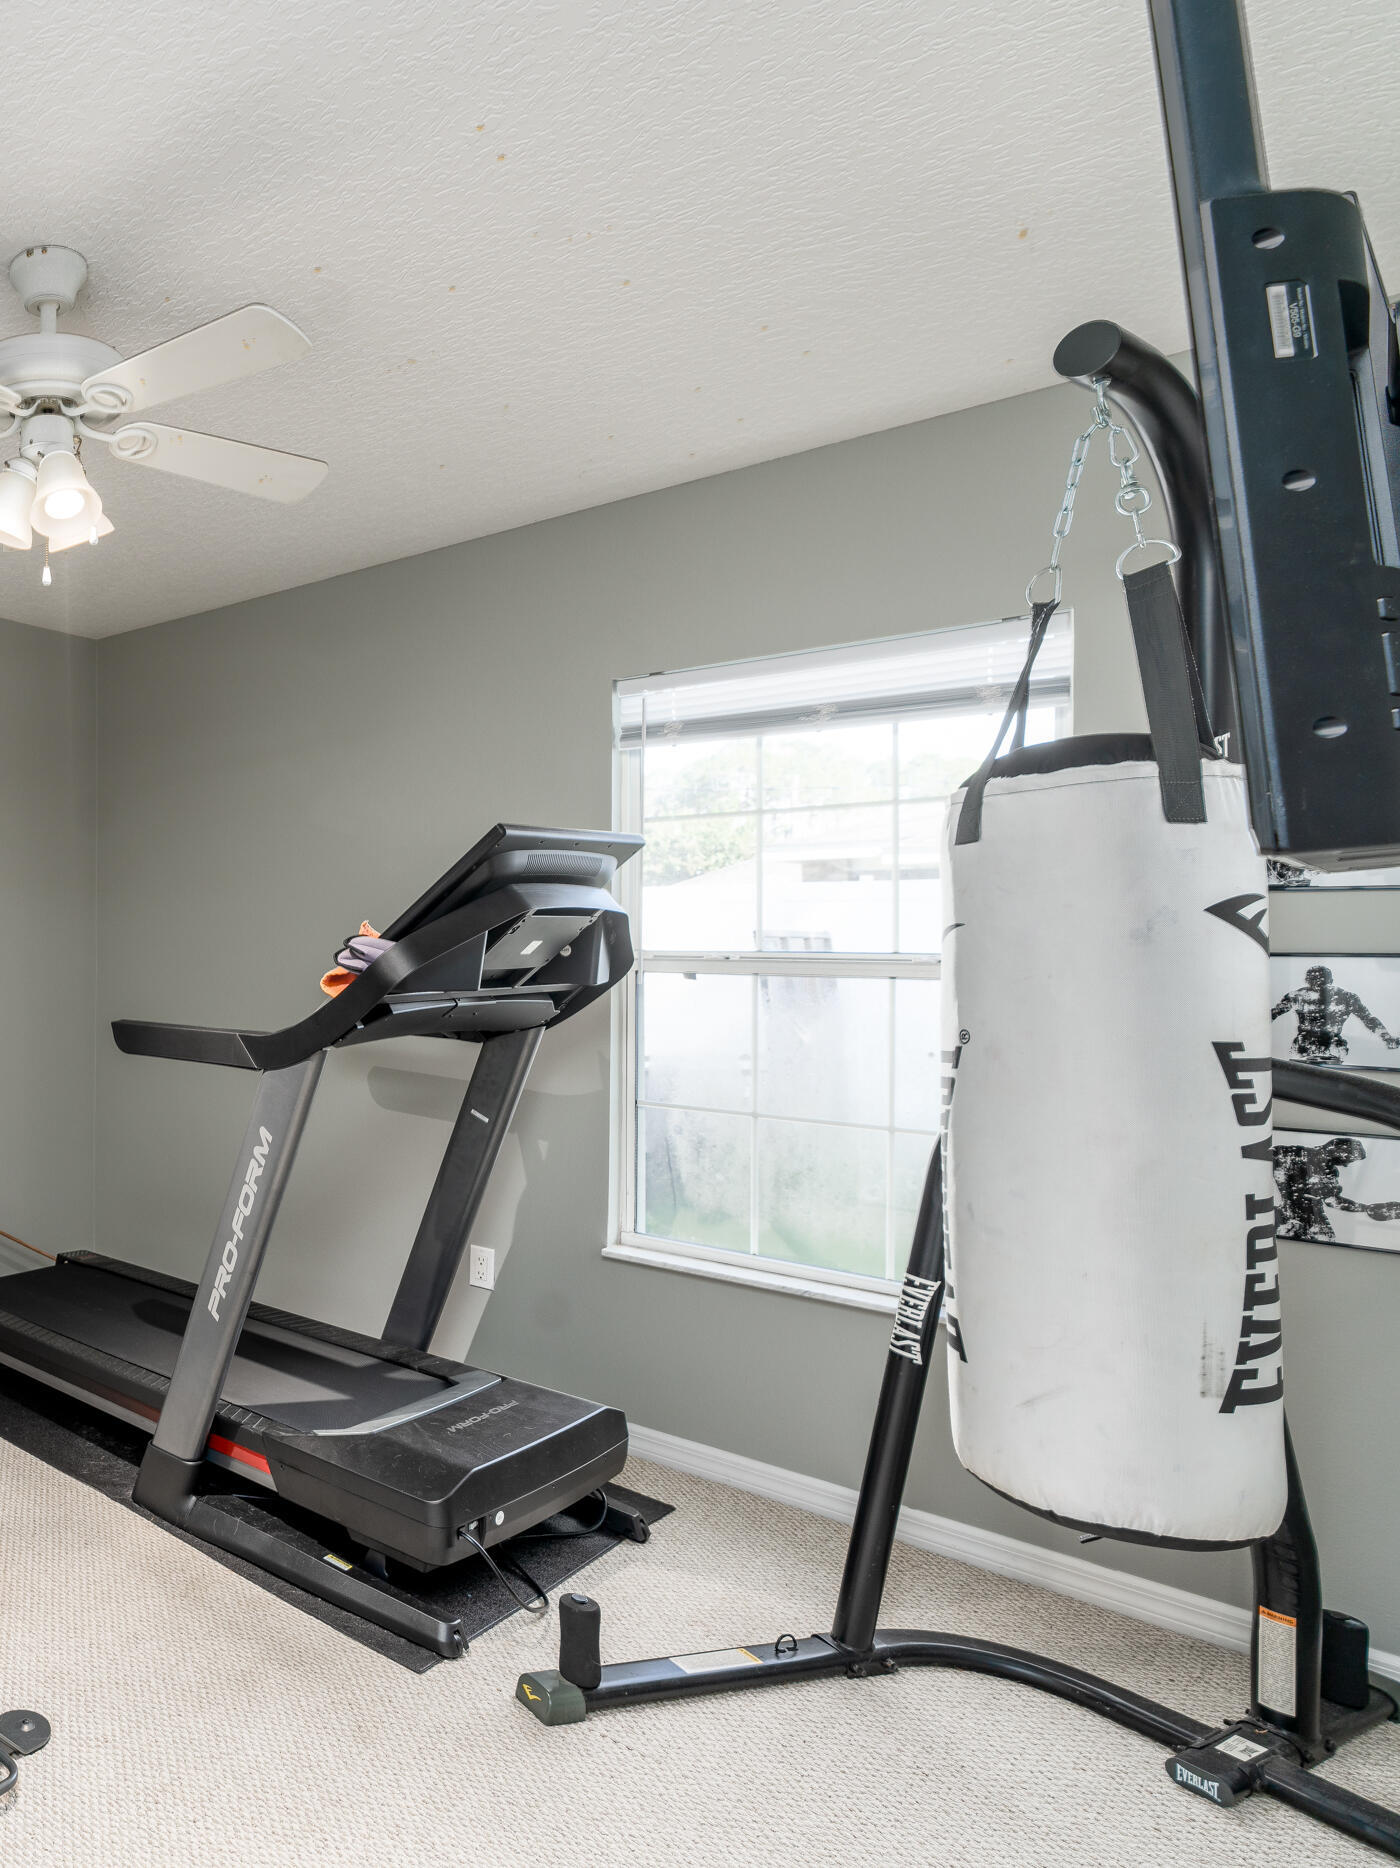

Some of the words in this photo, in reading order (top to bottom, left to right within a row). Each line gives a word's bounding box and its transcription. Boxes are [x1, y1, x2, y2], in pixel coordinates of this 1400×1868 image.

[208, 1126, 273, 1322] PRO-FORM
[889, 1272, 941, 1365] EVERLAST
[447, 1400, 519, 1435] PRO-FORM
[1176, 1762, 1220, 1800] EVERLAST
